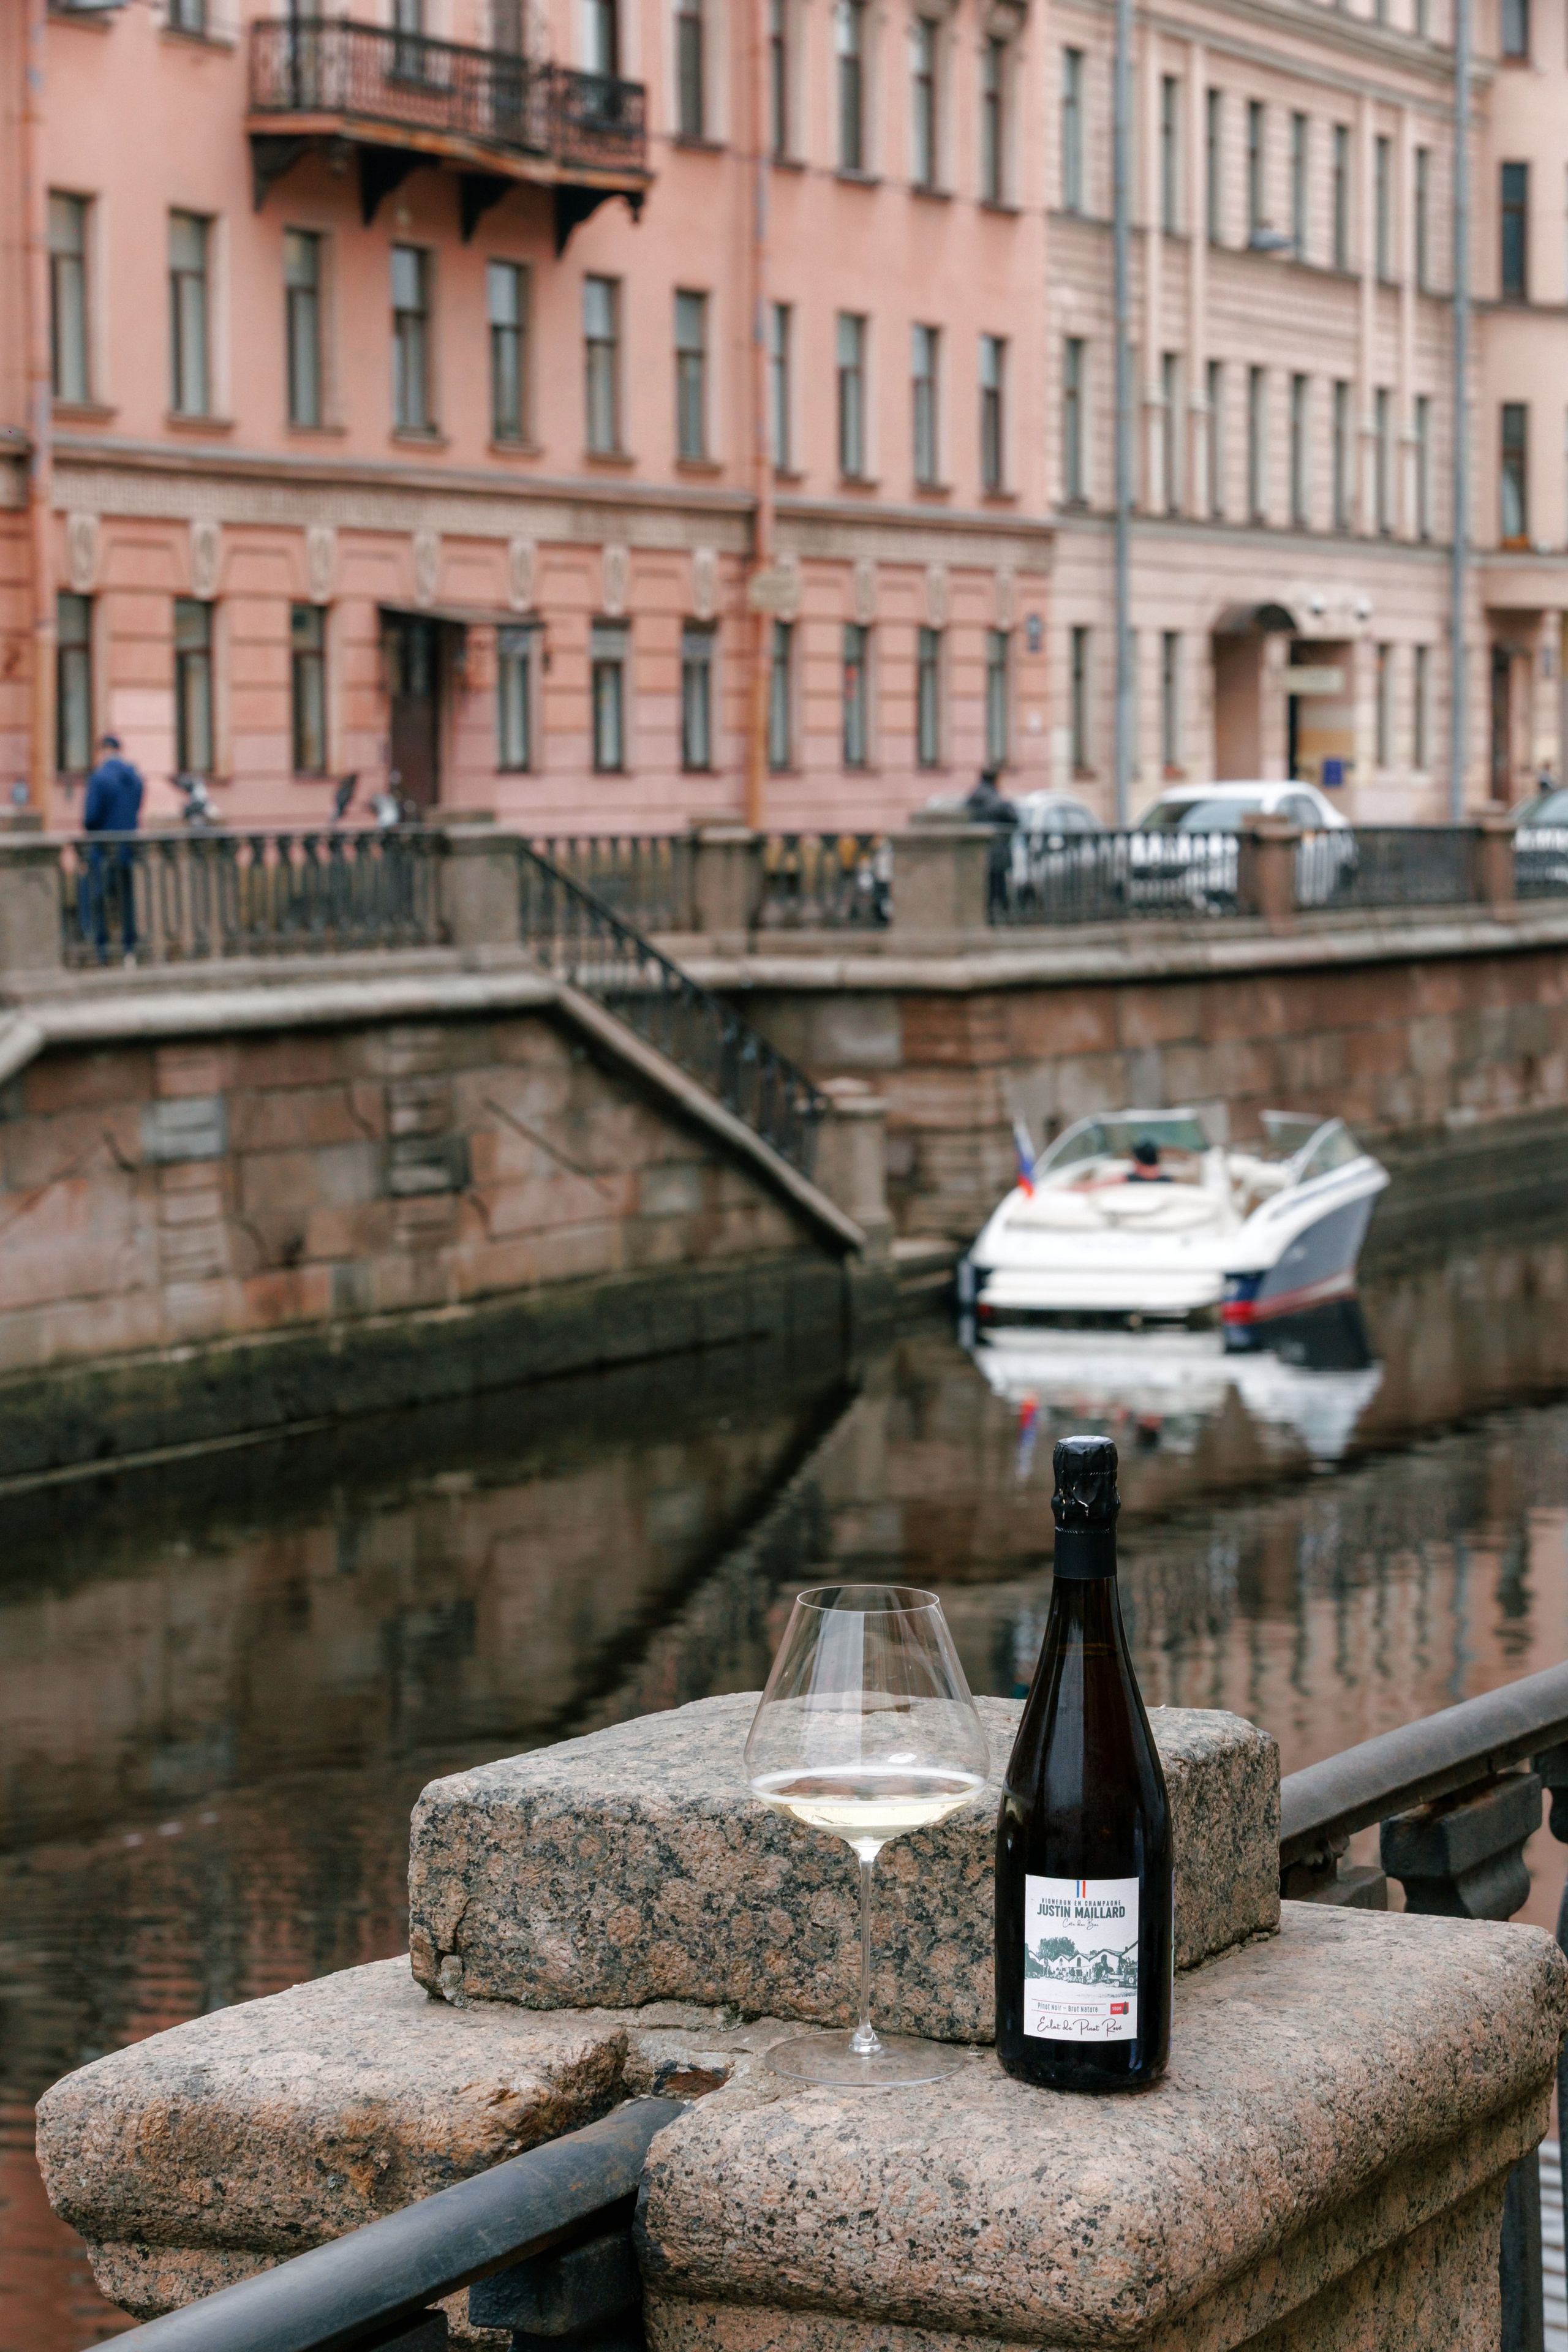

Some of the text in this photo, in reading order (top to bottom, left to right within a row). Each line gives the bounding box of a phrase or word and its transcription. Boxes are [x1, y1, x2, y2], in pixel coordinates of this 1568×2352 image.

[1037, 1903, 1126, 1919] JUSTIN MAILLARD
[1038, 2002, 1050, 2011] Pinot
[1062, 2019, 1073, 2031] de
[1072, 2018, 1100, 2035] Pinot
